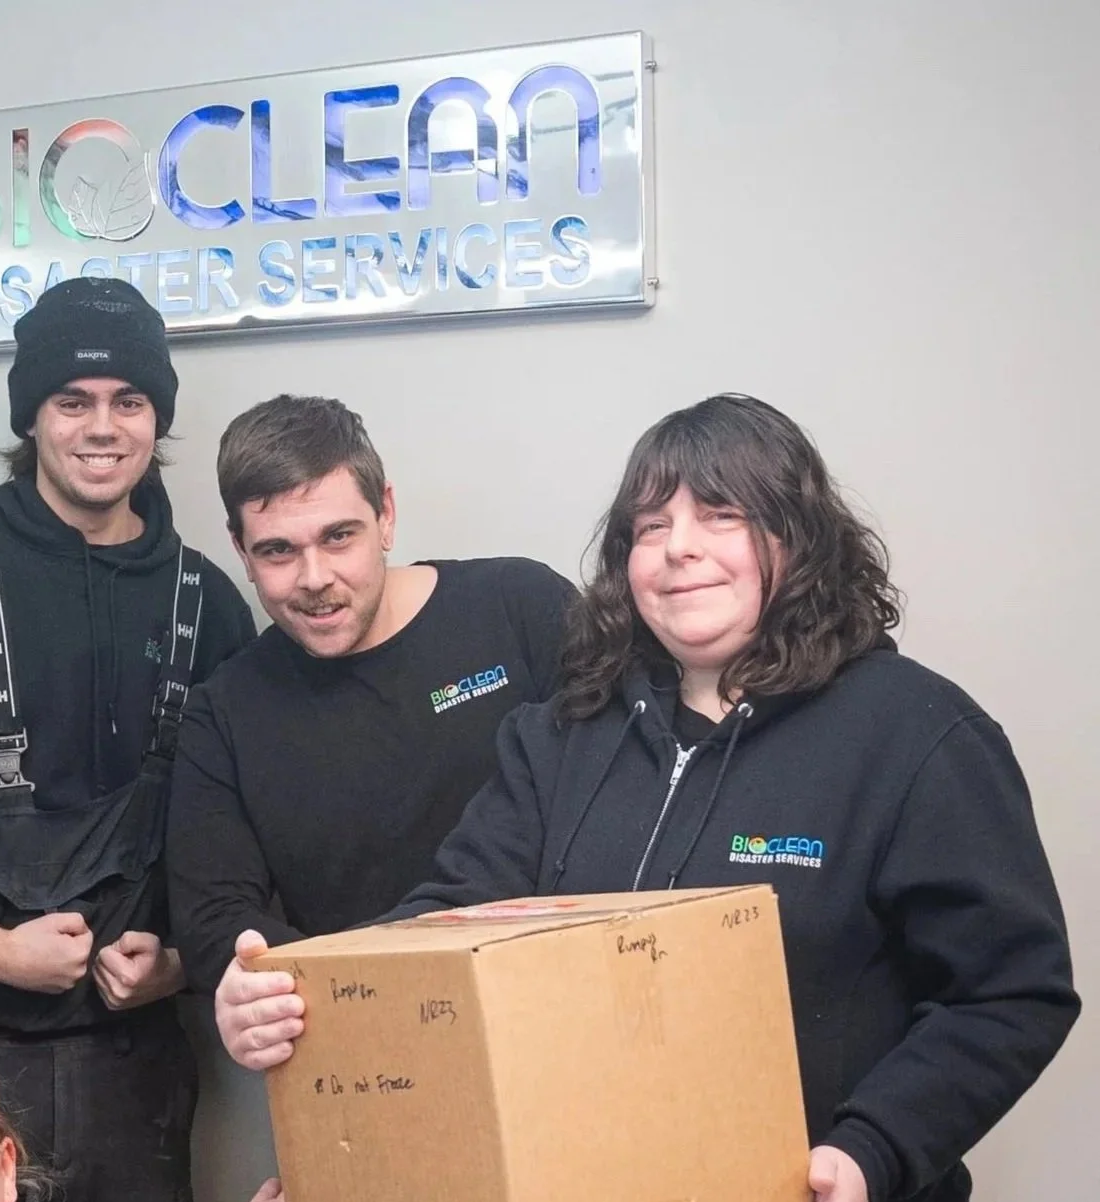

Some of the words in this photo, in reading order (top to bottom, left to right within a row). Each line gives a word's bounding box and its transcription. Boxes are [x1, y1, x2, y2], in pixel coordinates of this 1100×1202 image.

[256, 214, 592, 306] SERVICES
[77, 352, 109, 360] DAKOTA
[181, 571, 201, 586] HH
[176, 622, 194, 640] HH
[430, 664, 507, 706] BIOCLEAN
[433, 692, 472, 714] DISASTER
[471, 676, 509, 698] SERVICES
[731, 835, 824, 857] BIOCLEAN
[729, 852, 774, 865] DISASTER
[775, 853, 822, 868] SERVICES
[330, 1074, 344, 1096] Do
[354, 1080, 371, 1095] not
